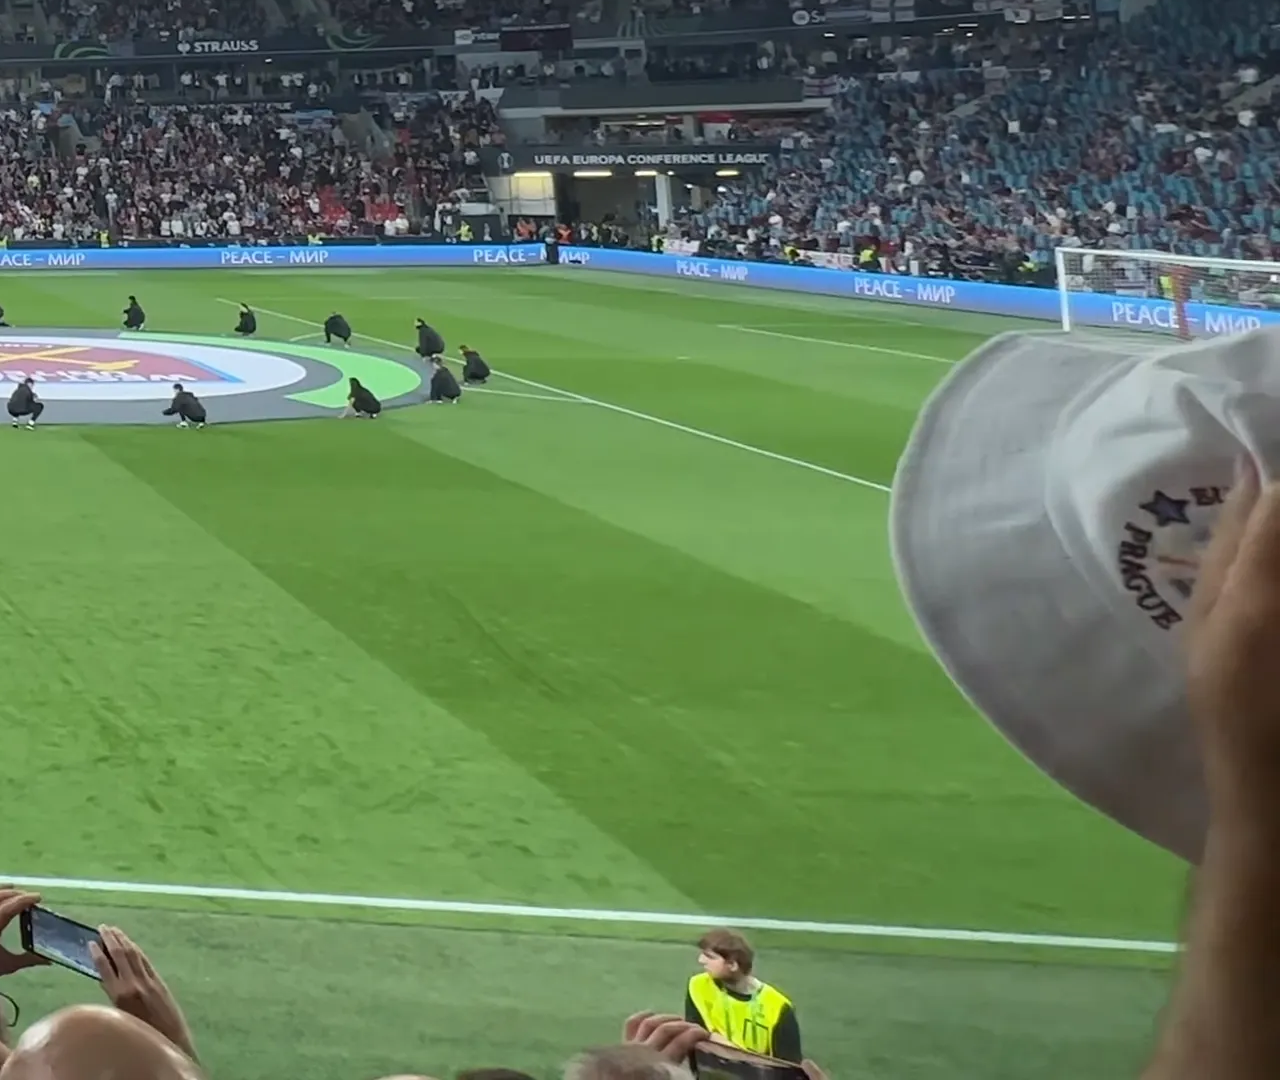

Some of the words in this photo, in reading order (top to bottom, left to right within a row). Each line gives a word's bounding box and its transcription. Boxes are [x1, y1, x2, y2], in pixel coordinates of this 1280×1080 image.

[193, 40, 259, 53] STRAUSS
[534, 155, 571, 165] UEFA
[572, 155, 625, 165] EUROPA
[626, 154, 716, 165] CONFERENCE
[48, 254, 85, 266] МИР
[221, 250, 272, 264] PEACE
[289, 250, 329, 264] МИР
[473, 249, 527, 263] PEACE
[676, 259, 711, 278] PEACE
[854, 277, 902, 299] PEACE
[917, 283, 955, 304] МИР
[1111, 301, 1180, 329] PEACE
[1117, 521, 1183, 631] PRAGUE
